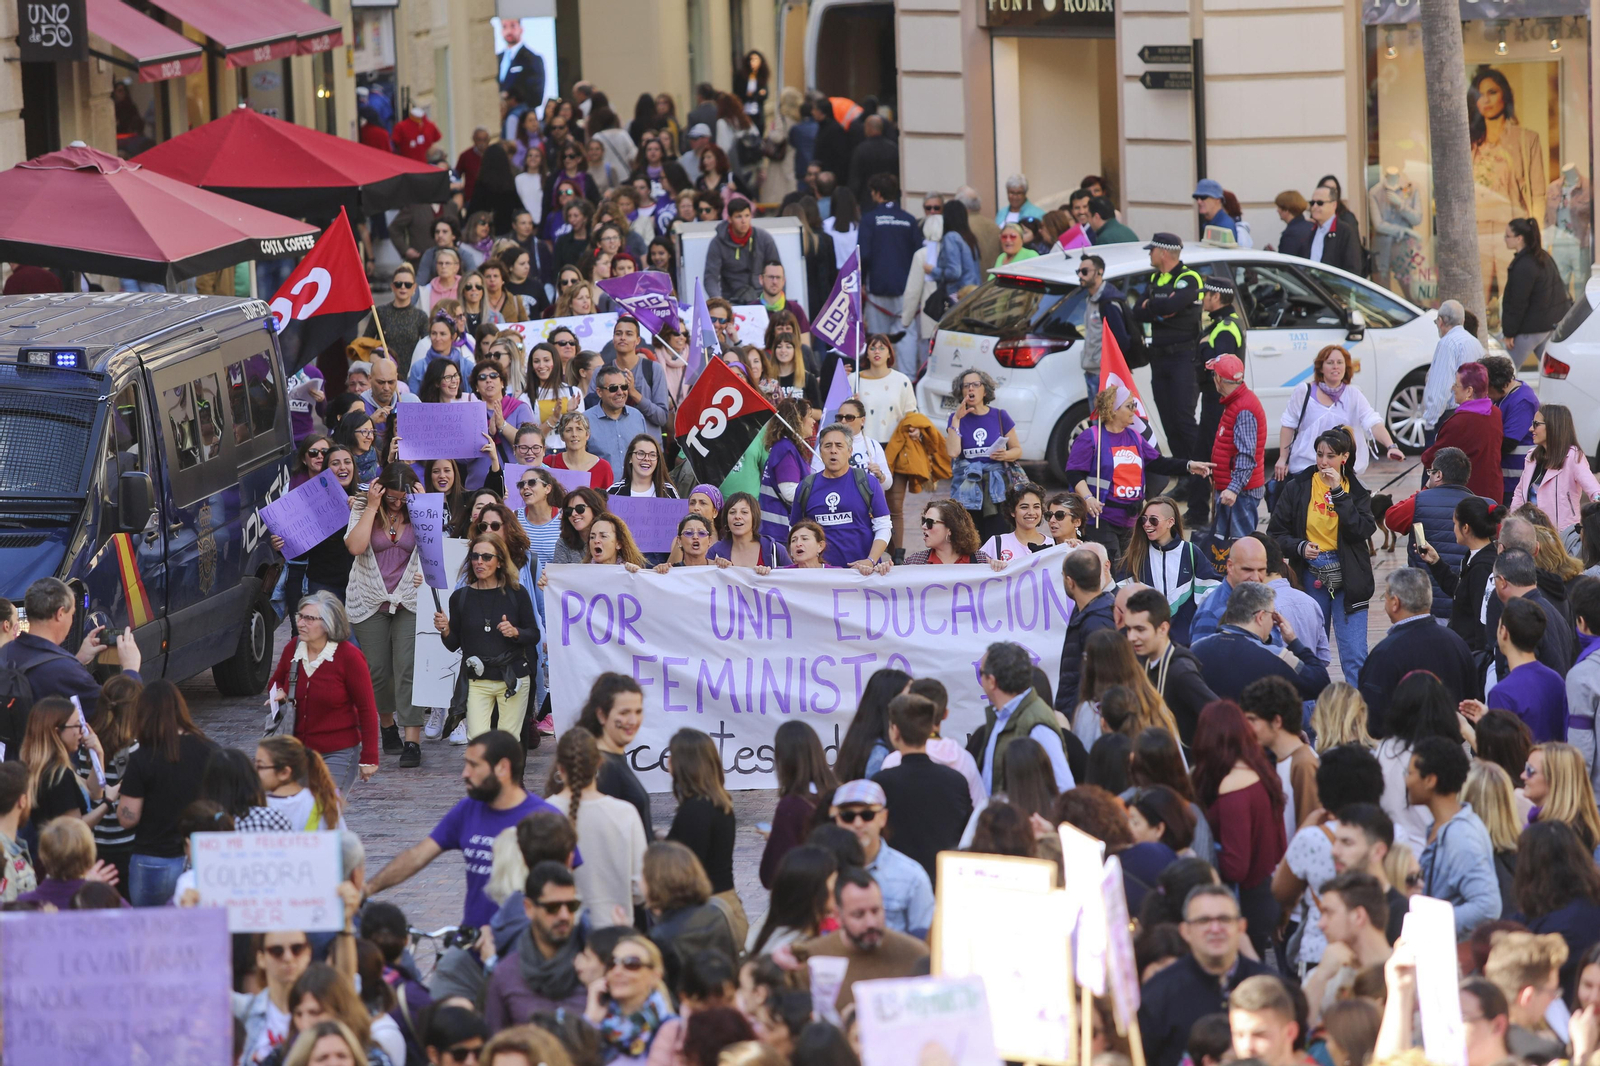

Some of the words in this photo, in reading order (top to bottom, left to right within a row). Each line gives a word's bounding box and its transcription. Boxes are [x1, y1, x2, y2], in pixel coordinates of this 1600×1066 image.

[27, 3, 70, 24] UNO
[260, 240, 285, 256] COSTA
[1289, 332, 1309, 341] TAXI
[1292, 341, 1308, 350] 372
[1115, 485, 1142, 499] CGT
[815, 513, 852, 522] FELMA
[560, 589, 646, 646] POR
[710, 584, 793, 641] UNA
[832, 555, 1076, 642] EDUCACIÓN
[203, 860, 317, 888] COLABORA
